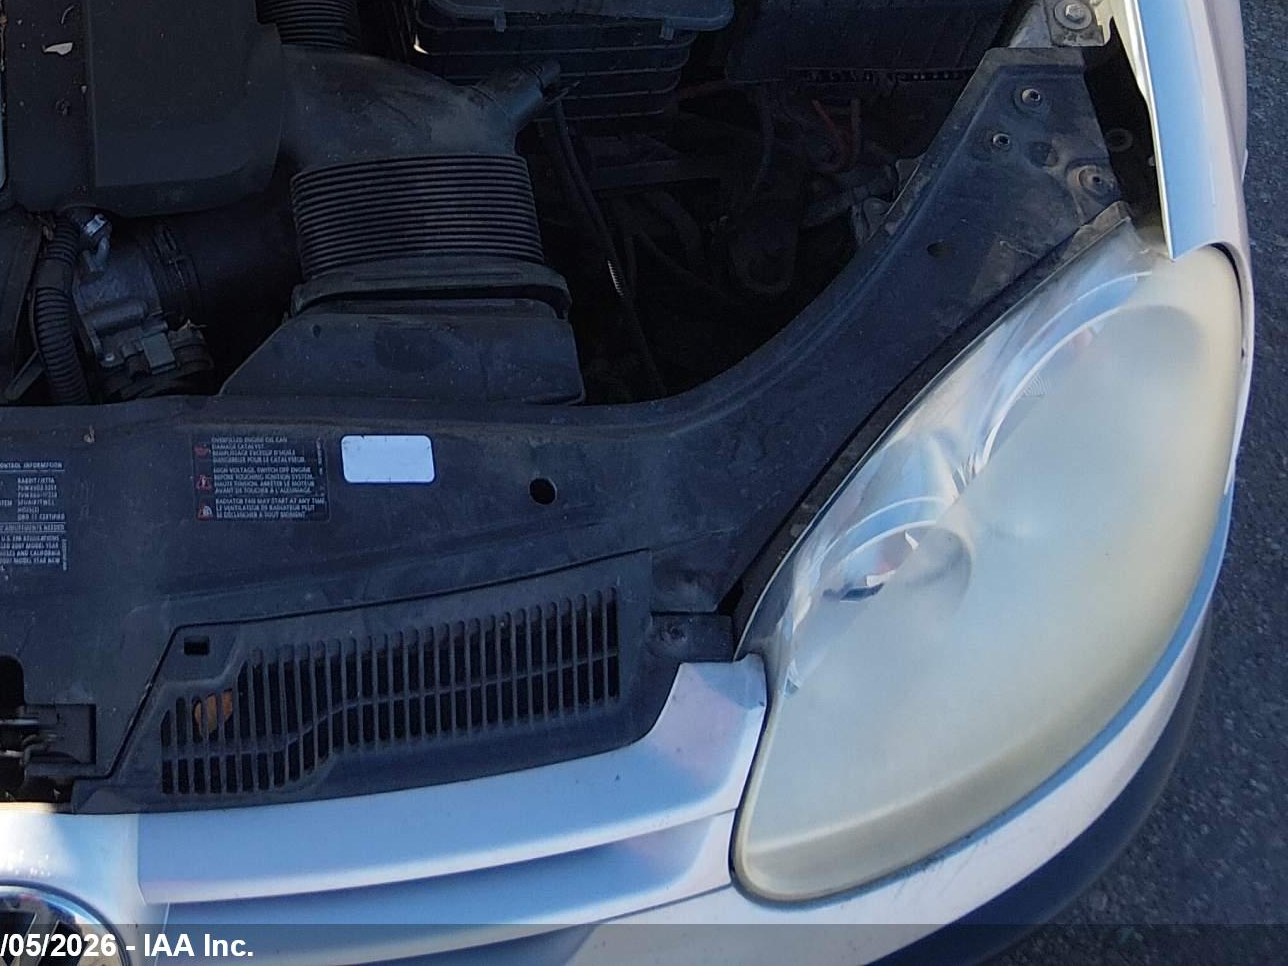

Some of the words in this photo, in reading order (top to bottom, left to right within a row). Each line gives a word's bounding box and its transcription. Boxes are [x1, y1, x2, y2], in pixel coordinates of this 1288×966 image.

[215, 497, 244, 505] RADIATOR
[257, 497, 270, 505] MAY
[271, 497, 289, 505] START
[298, 497, 311, 505] ANY
